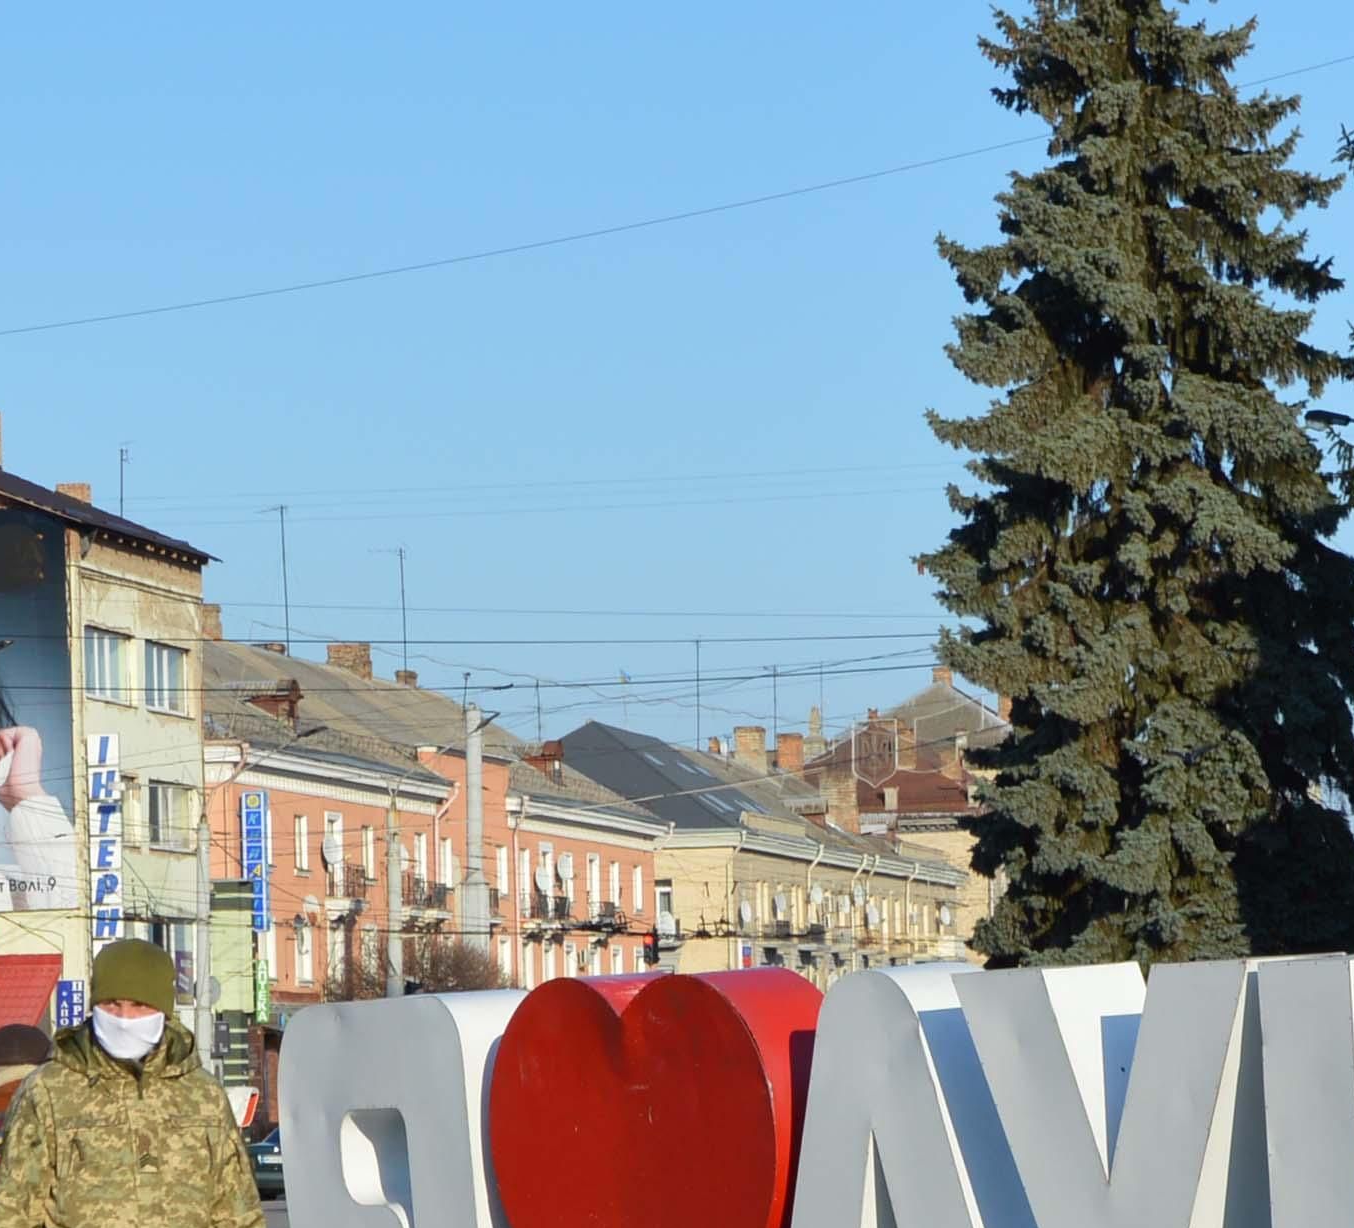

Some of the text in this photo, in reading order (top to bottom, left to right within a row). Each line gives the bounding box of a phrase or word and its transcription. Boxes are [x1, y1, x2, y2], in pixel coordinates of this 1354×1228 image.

[91, 736, 120, 938] ІНТЕРН
[9, 878, 44, 893] Волі,
[47, 876, 57, 892] 9
[60, 1000, 69, 1026] АПО
[256, 960, 269, 1023] АПТЕКА
